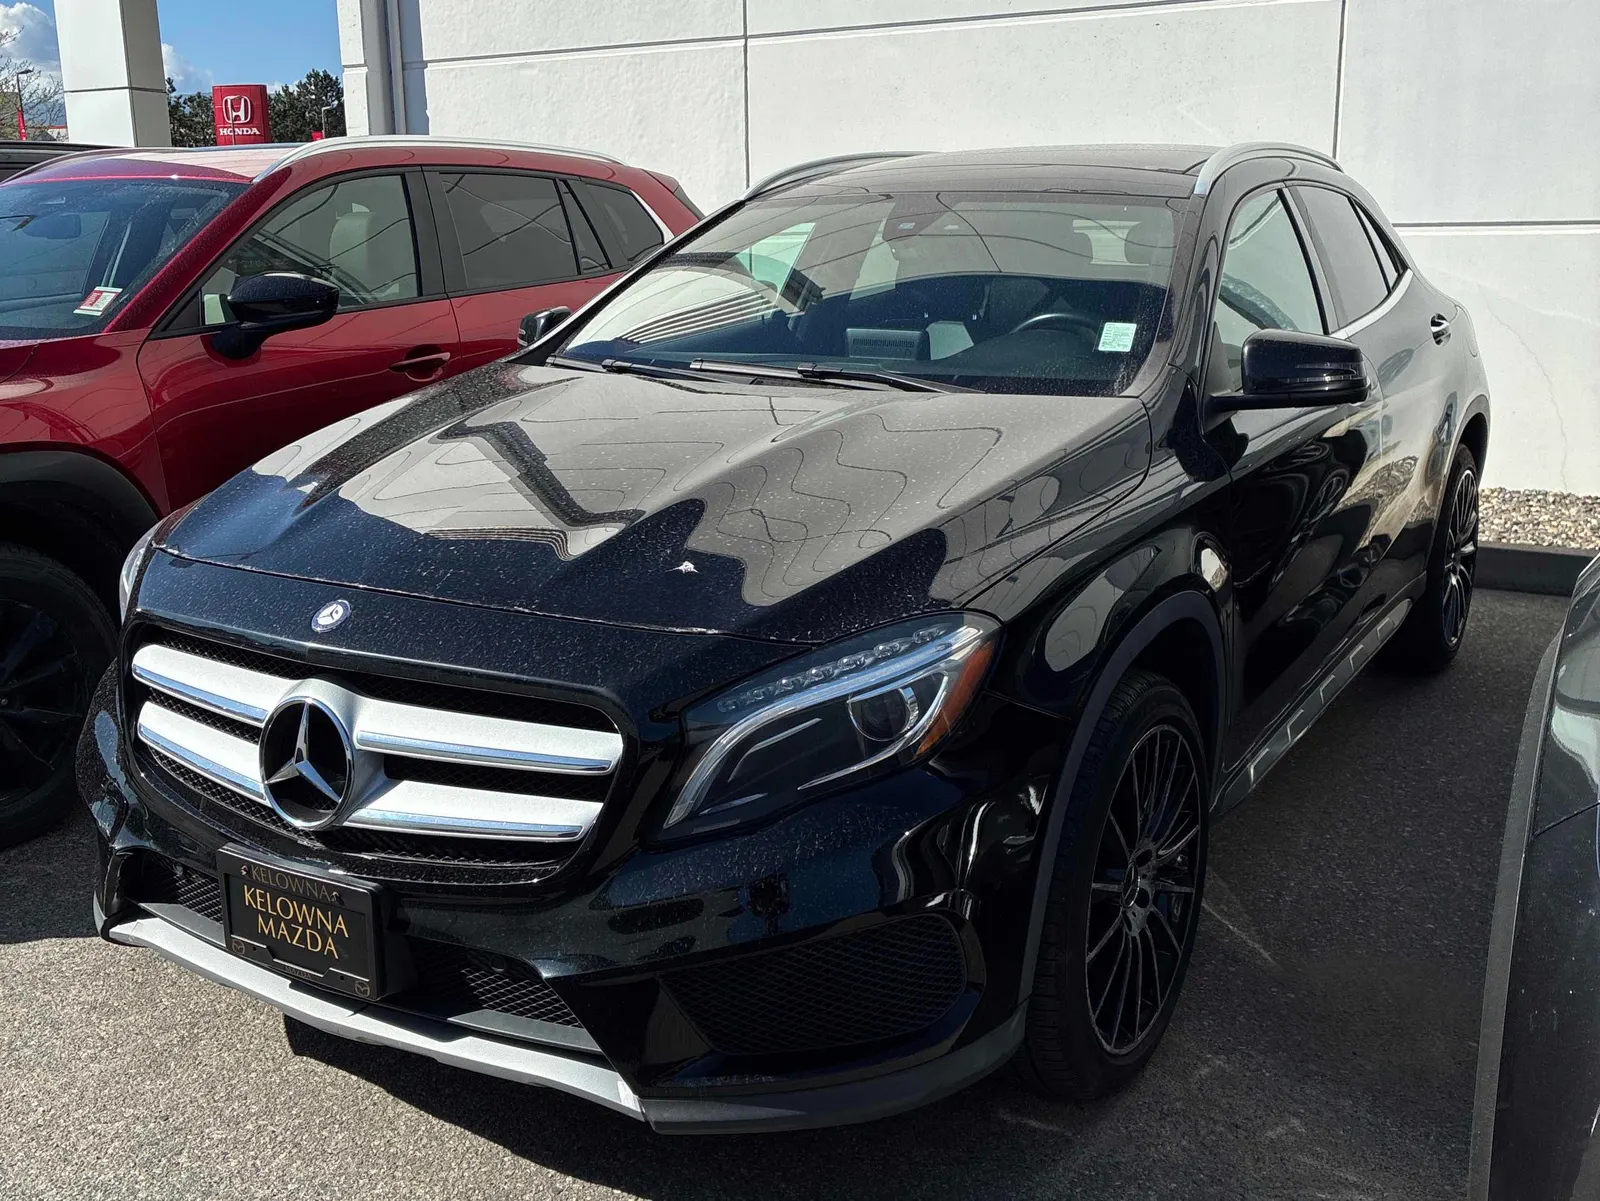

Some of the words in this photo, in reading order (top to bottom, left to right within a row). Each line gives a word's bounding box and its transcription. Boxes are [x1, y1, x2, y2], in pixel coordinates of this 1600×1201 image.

[219, 127, 261, 136] HONDA
[251, 864, 331, 902] KELOWNA
[244, 885, 349, 938] KELOWNA
[257, 914, 339, 960] MAZDA
